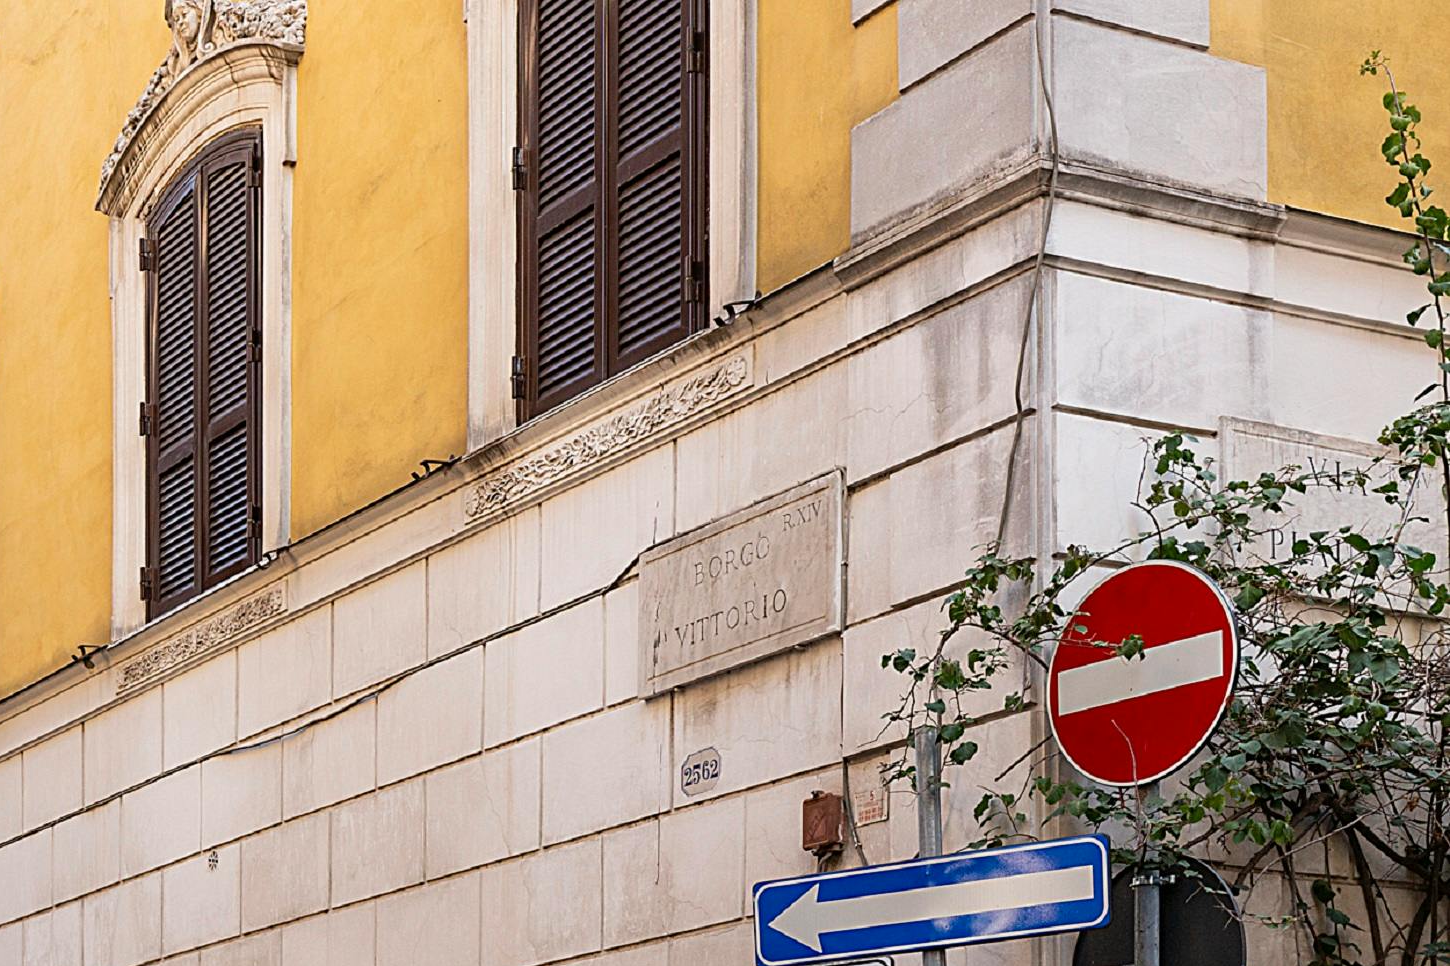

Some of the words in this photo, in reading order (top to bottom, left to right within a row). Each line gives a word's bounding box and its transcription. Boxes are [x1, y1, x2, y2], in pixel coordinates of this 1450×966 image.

[694, 534, 770, 586] BORGO
[675, 588, 788, 647] VITTORIO
[684, 759, 719, 787] 2562
